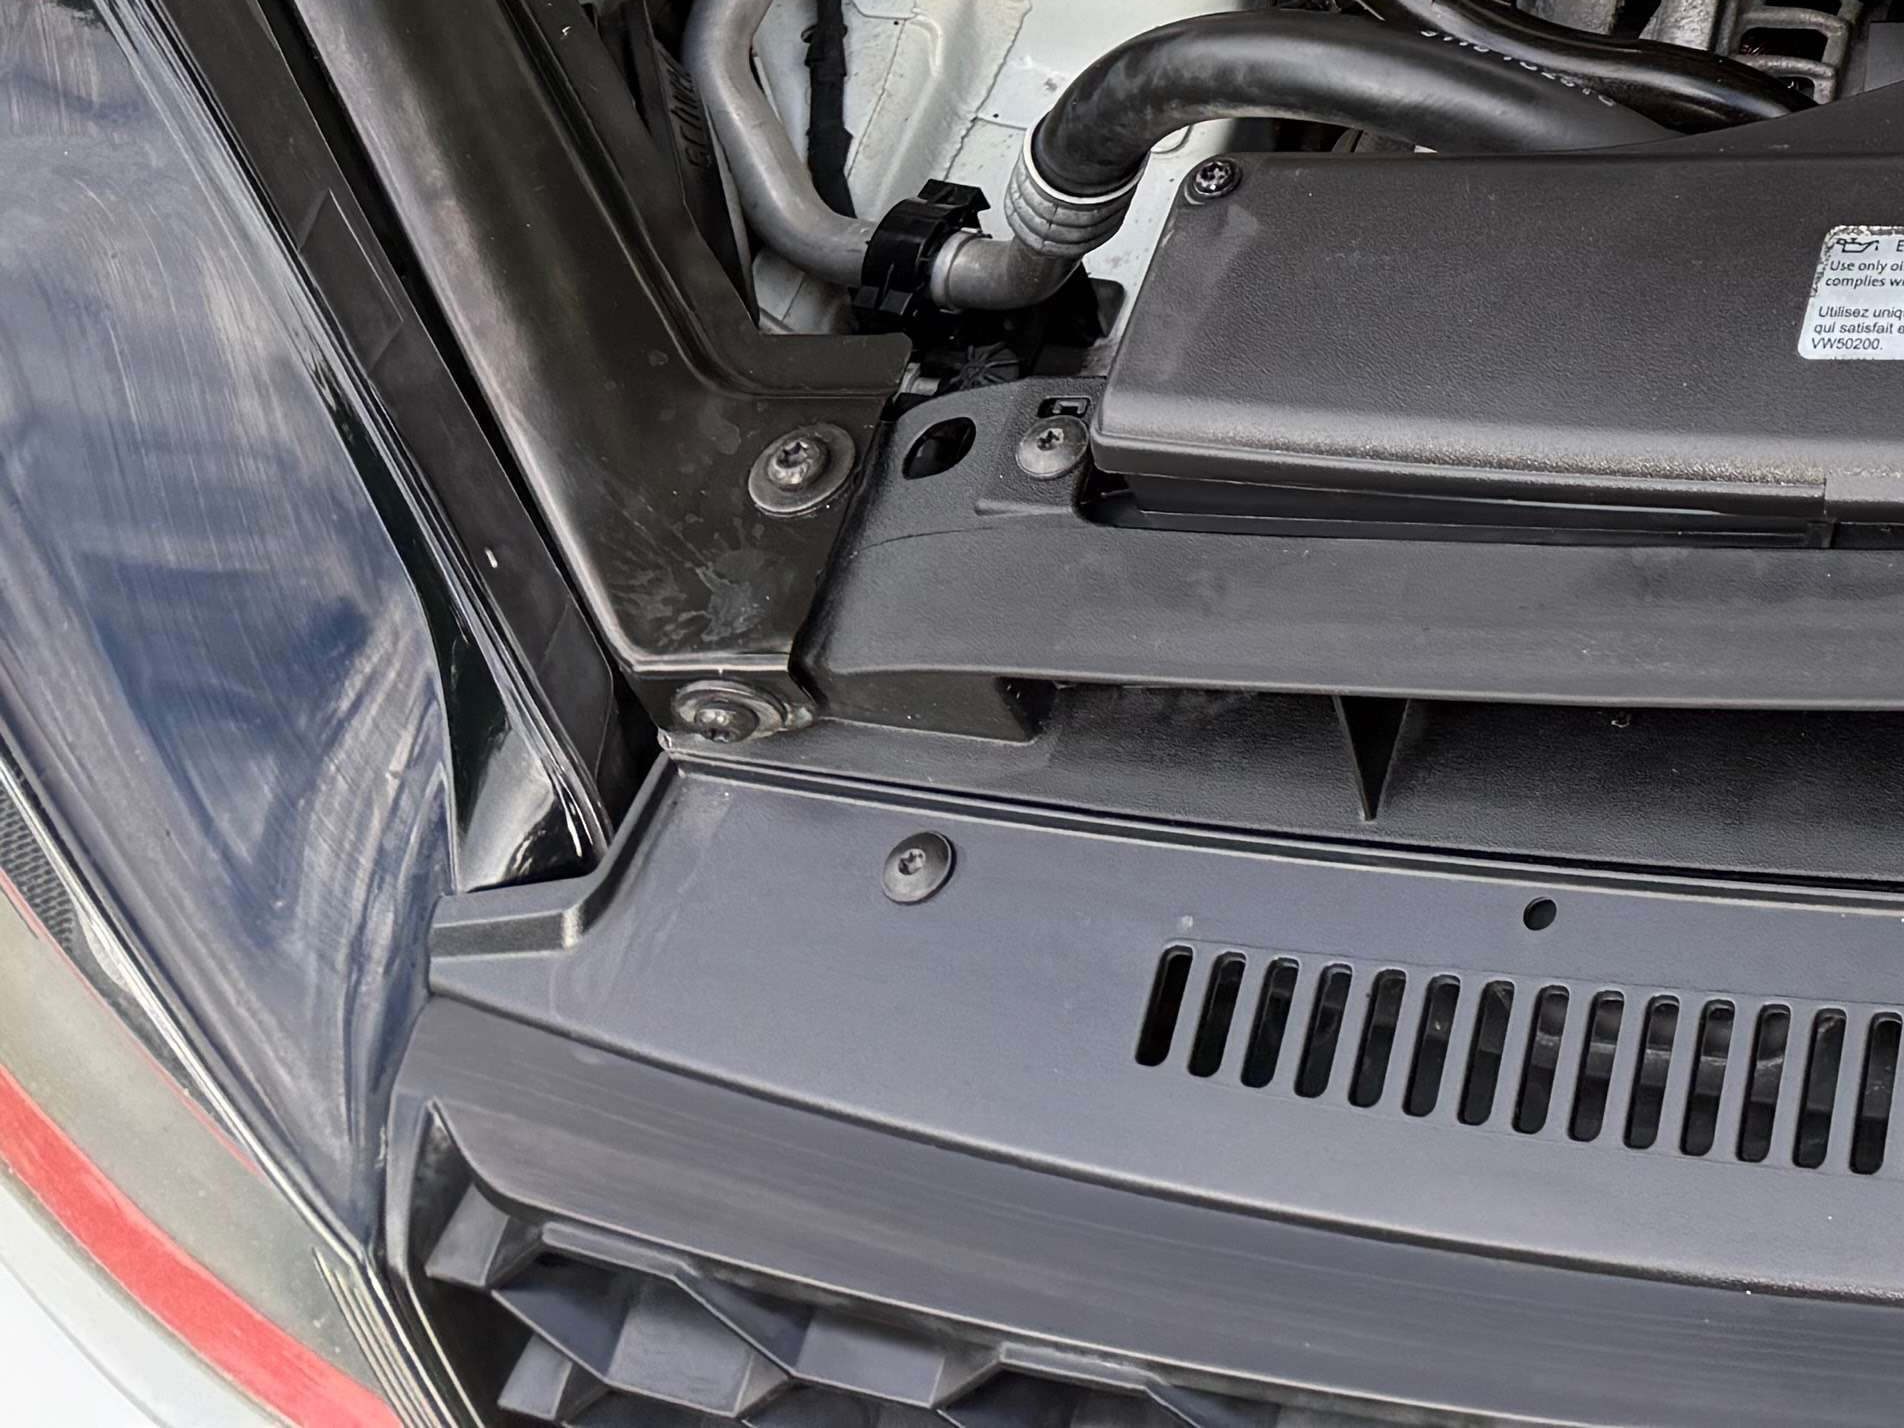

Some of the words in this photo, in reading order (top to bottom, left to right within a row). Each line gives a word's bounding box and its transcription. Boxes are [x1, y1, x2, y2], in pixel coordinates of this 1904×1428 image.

[1830, 261, 1855, 272] Use
[1858, 261, 1888, 273] only
[1825, 276, 1885, 288] complies
[1818, 307, 1869, 319] Utilisez
[1814, 323, 1835, 335] qui
[1840, 323, 1893, 335] satisfait
[1811, 338, 1883, 350] VW50200.
